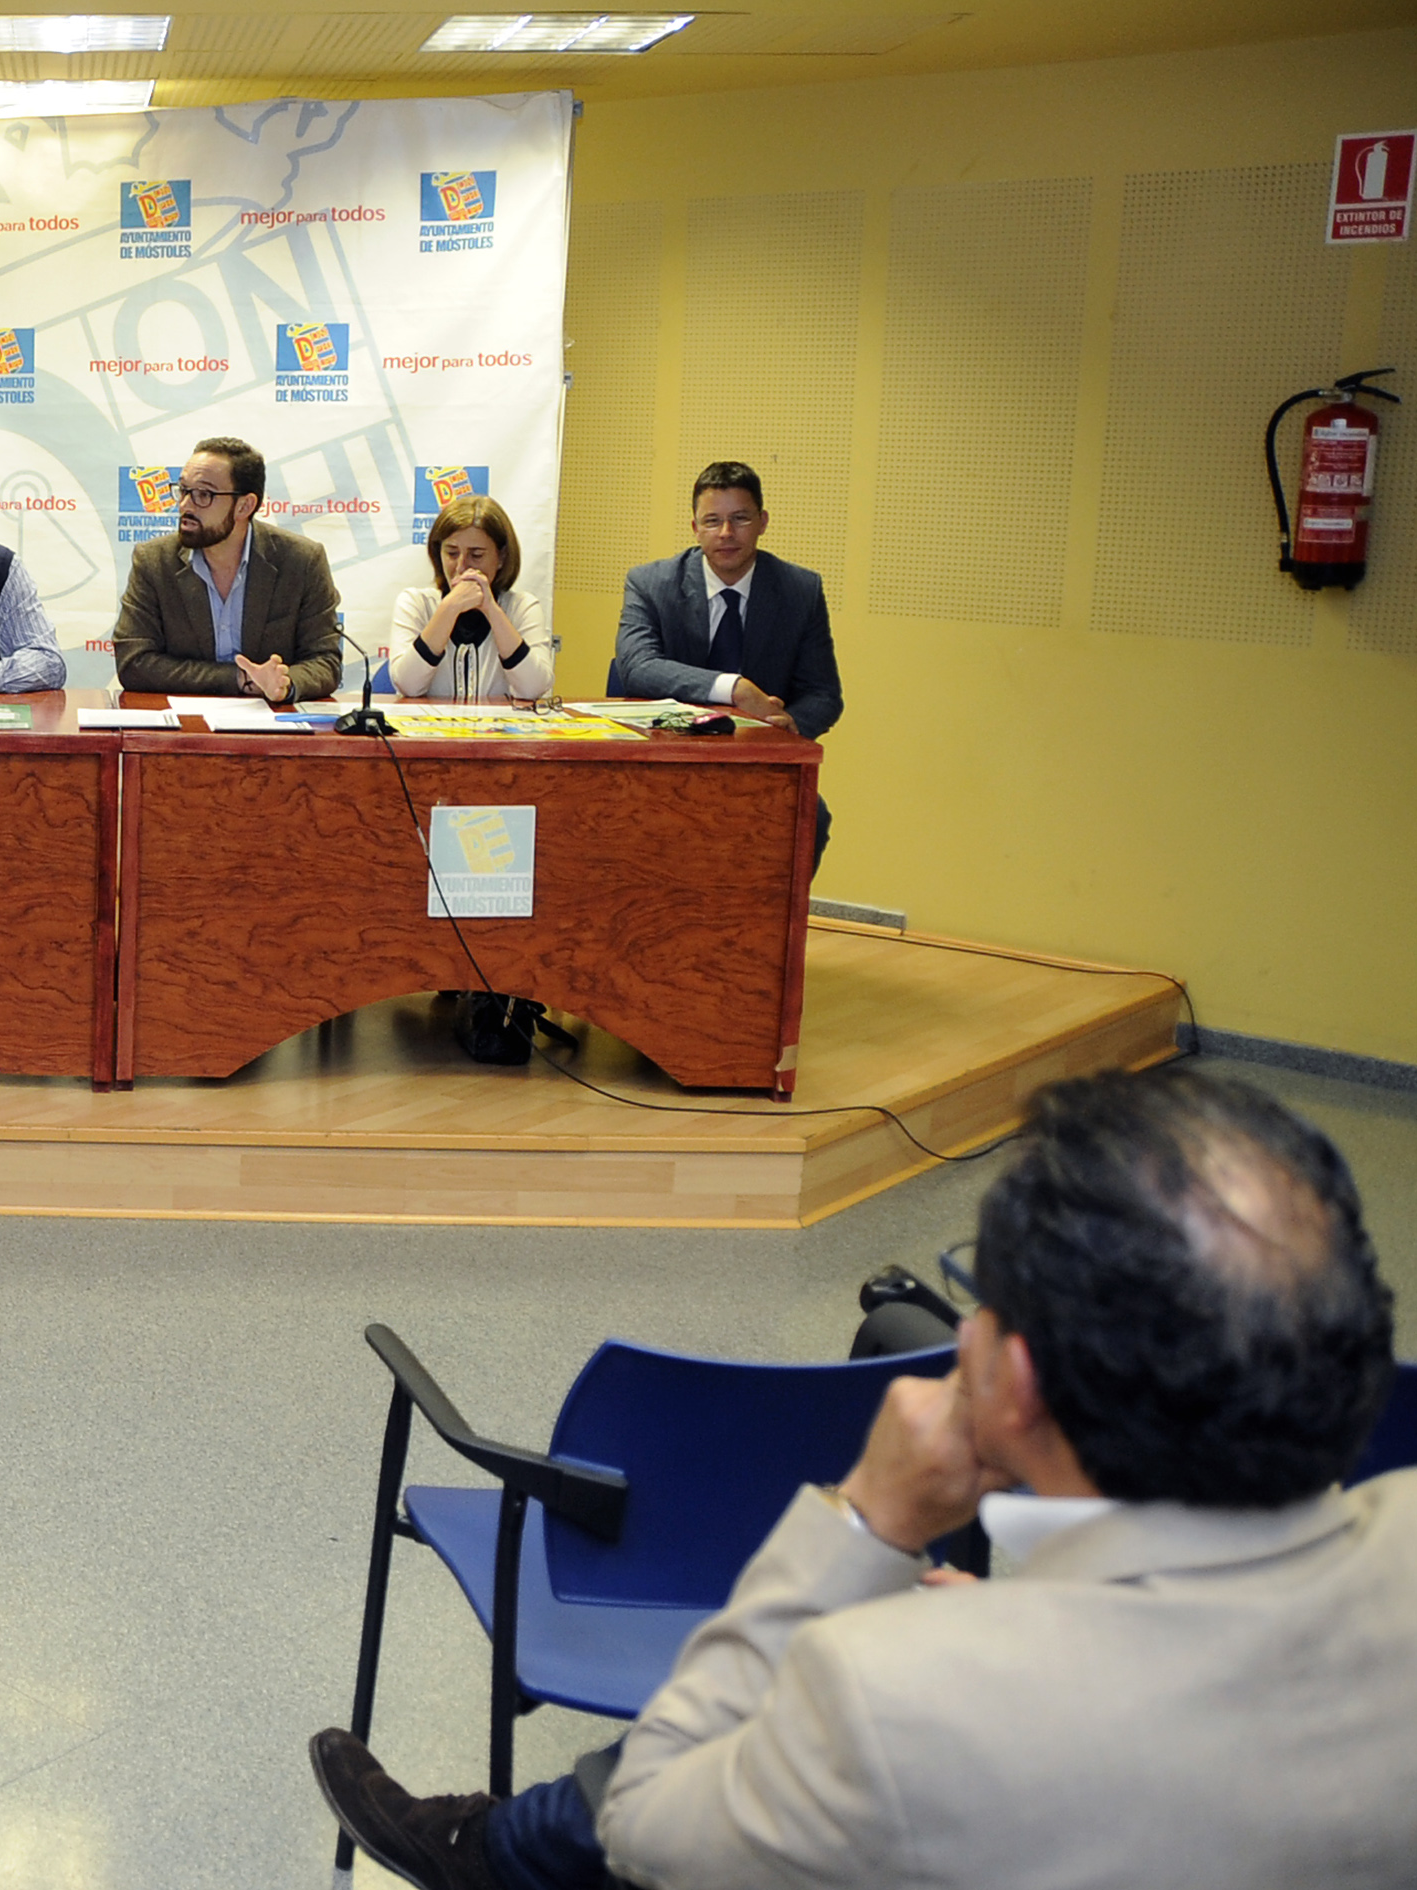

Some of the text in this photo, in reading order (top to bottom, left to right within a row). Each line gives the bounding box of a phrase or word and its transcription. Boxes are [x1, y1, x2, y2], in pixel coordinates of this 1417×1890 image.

[30, 215, 80, 231] todos
[241, 205, 386, 229] mejor para todos
[1336, 209, 1402, 223] EXTINTOR DE
[120, 230, 192, 243] AYUNTAMIENTO
[420, 221, 494, 236] AYUNTAMIENTO
[1339, 223, 1396, 235] INCENDIOS
[120, 242, 192, 259] DE MÓSTOLES
[420, 236, 494, 253] DE MÓSTOLES
[90, 355, 230, 376] mejor para todos
[382, 350, 533, 373] mejor para todos
[276, 375, 348, 387] AYUNTAMIENTO
[276, 386, 348, 402] DE MÓSTOLES
[26, 496, 77, 511] todos
[292, 503, 323, 516] para
[327, 498, 381, 513] todos
[118, 529, 131, 542] DE
